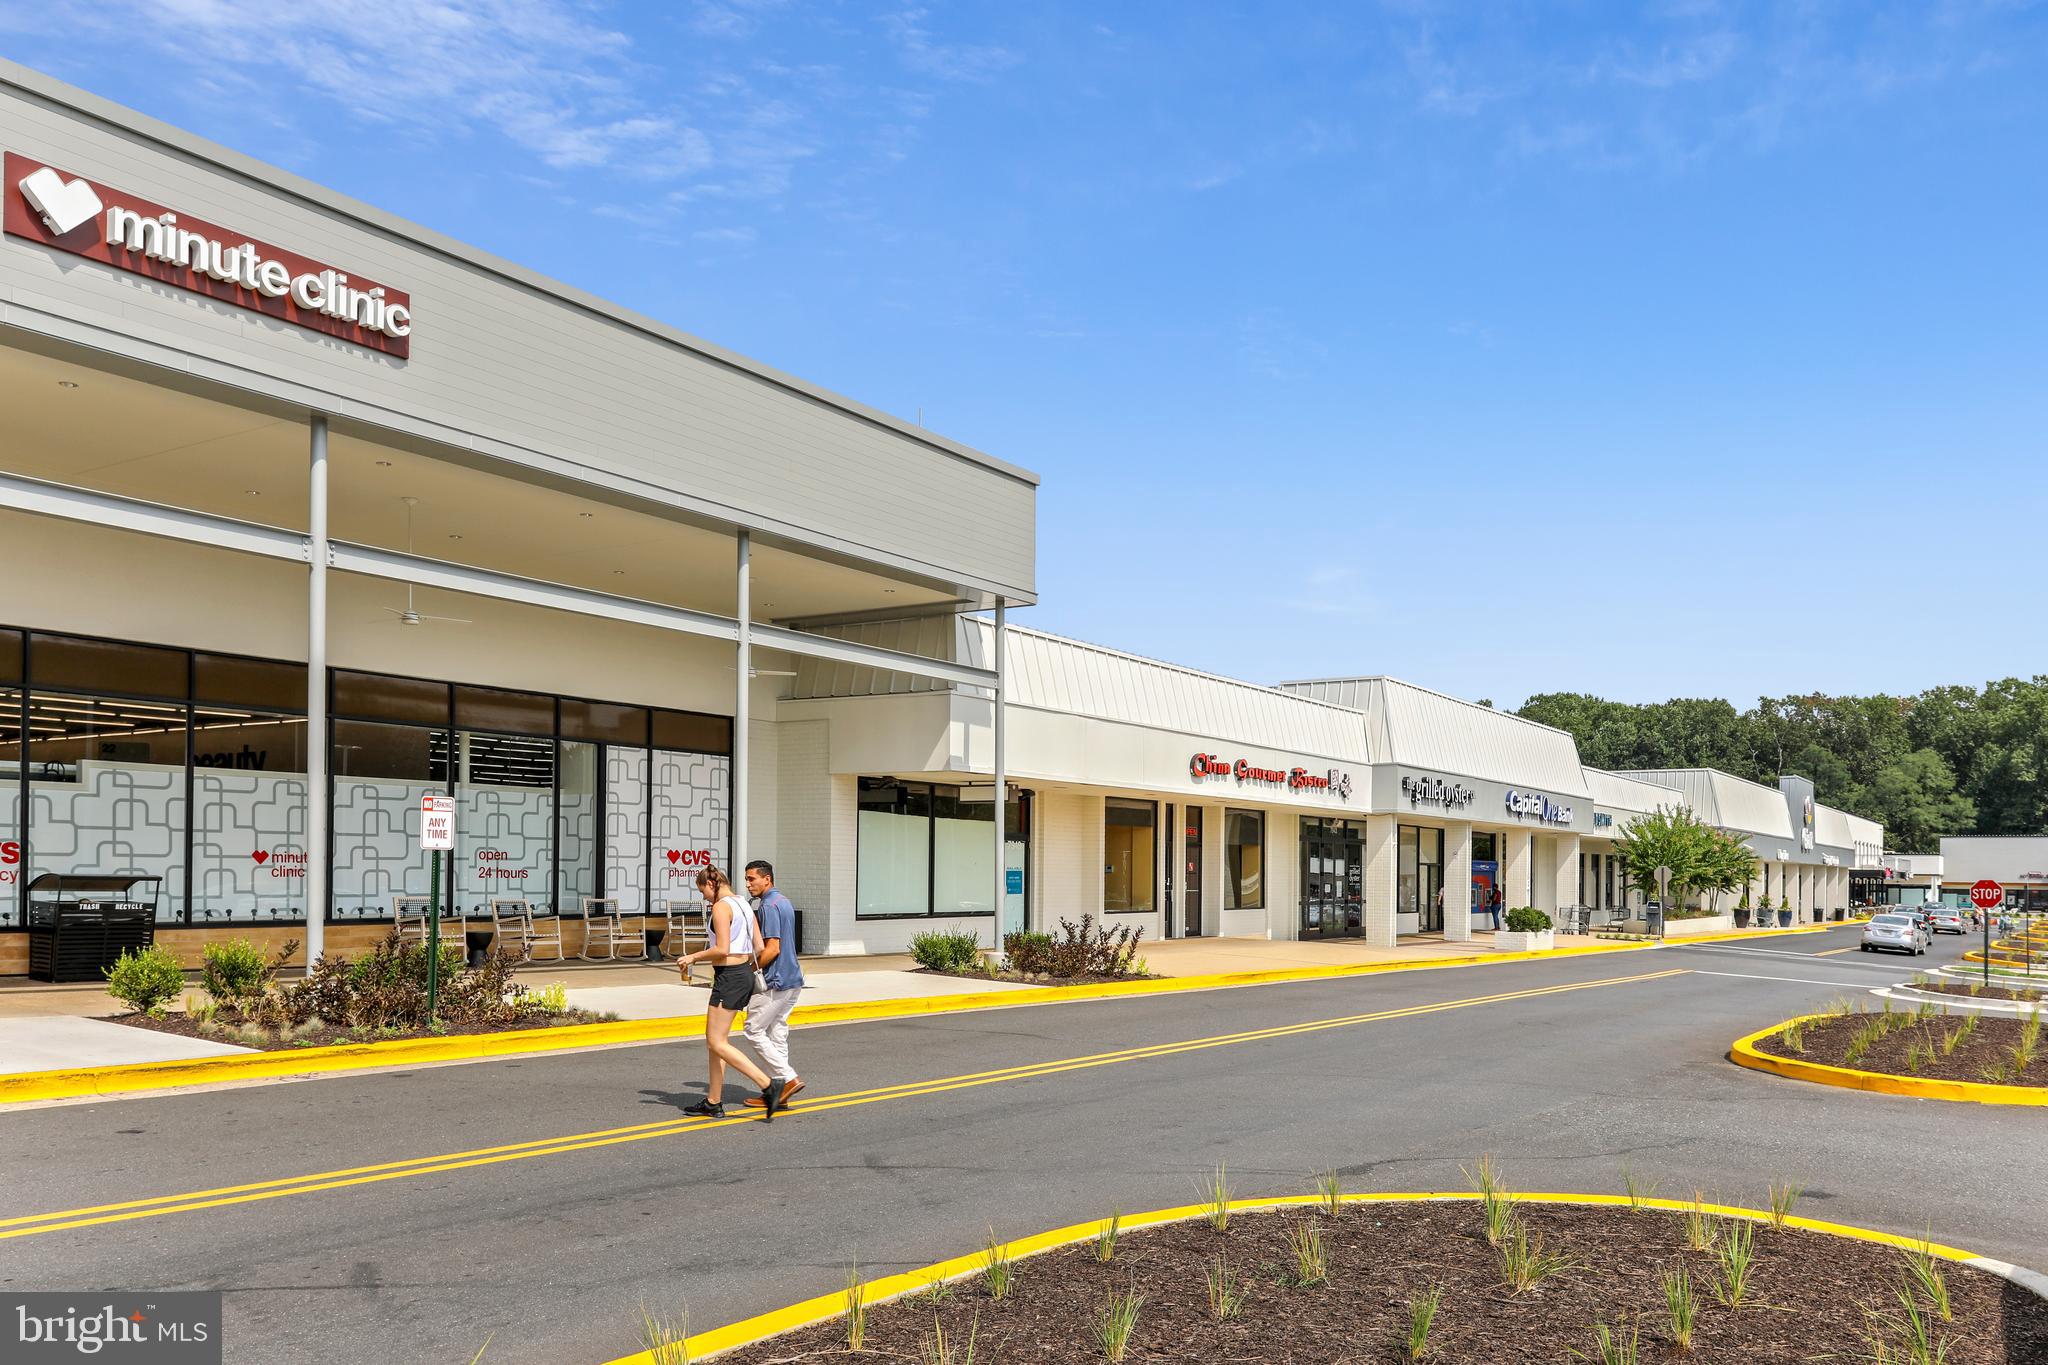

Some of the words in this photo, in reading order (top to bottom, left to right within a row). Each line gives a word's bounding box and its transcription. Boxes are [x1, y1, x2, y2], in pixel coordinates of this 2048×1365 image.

[106, 205, 290, 297] minute
[291, 268, 411, 338] clinic
[1190, 753, 1231, 778] China
[1234, 759, 1286, 782] Gourmet
[1288, 767, 1328, 788] Bistro
[1412, 777, 1444, 802] grilled
[1444, 784, 1472, 807] oyster
[1506, 791, 1543, 817] Capital
[1543, 796, 1558, 821] One
[1557, 808, 1573, 823] Bank
[429, 818, 446, 827] ANY
[427, 830, 448, 839] TIME
[271, 851, 308, 863] minut
[479, 851, 508, 862] open
[681, 850, 711, 865] CVS
[271, 865, 305, 877] clinic
[479, 867, 492, 878] 24
[496, 867, 528, 878] hours
[669, 868, 700, 879] pharma
[1972, 888, 2001, 900] STOP
